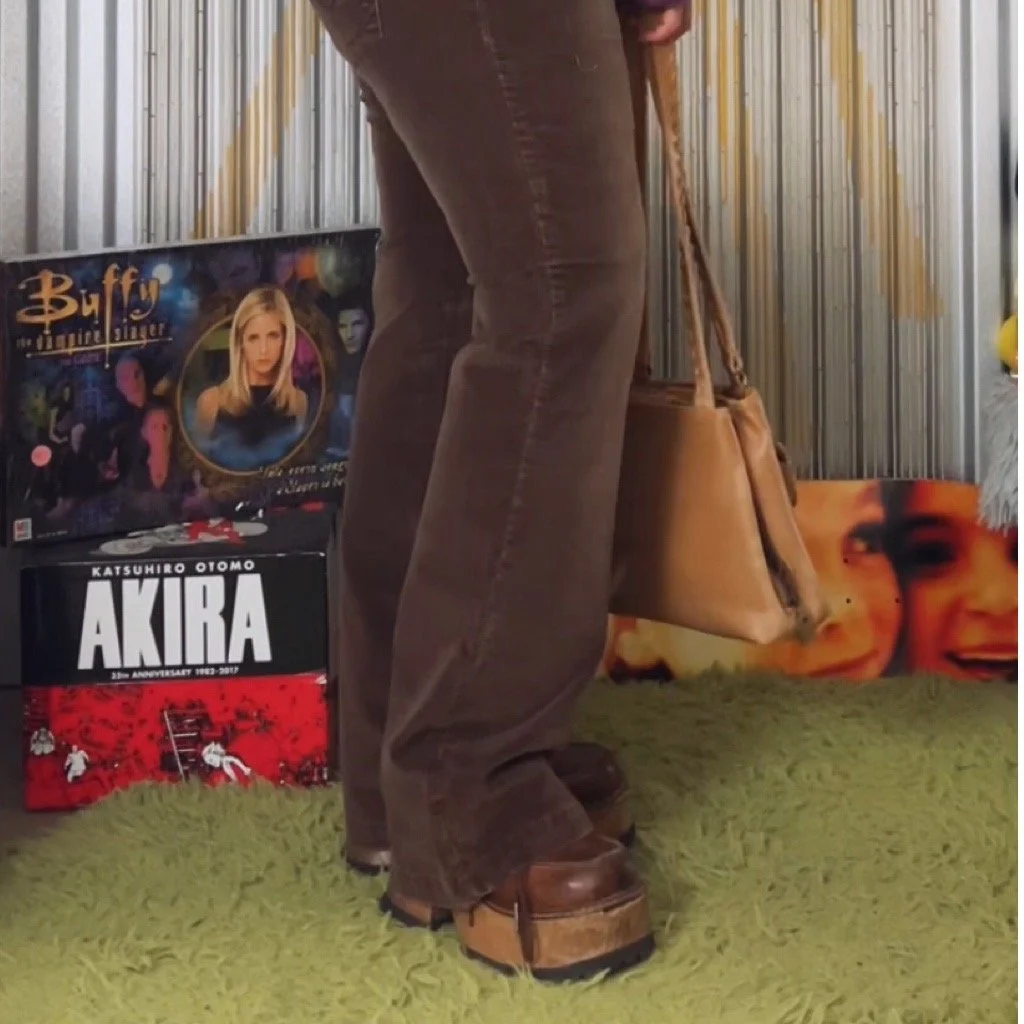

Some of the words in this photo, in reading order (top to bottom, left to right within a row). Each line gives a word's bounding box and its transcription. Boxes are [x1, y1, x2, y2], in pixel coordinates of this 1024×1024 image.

[16, 262, 160, 369] Buffy
[91, 562, 186, 578] KATSUHIRO
[195, 560, 256, 574] OTOMO
[77, 573, 272, 670] AKIRA
[132, 668, 192, 679] ANNIVERSARY
